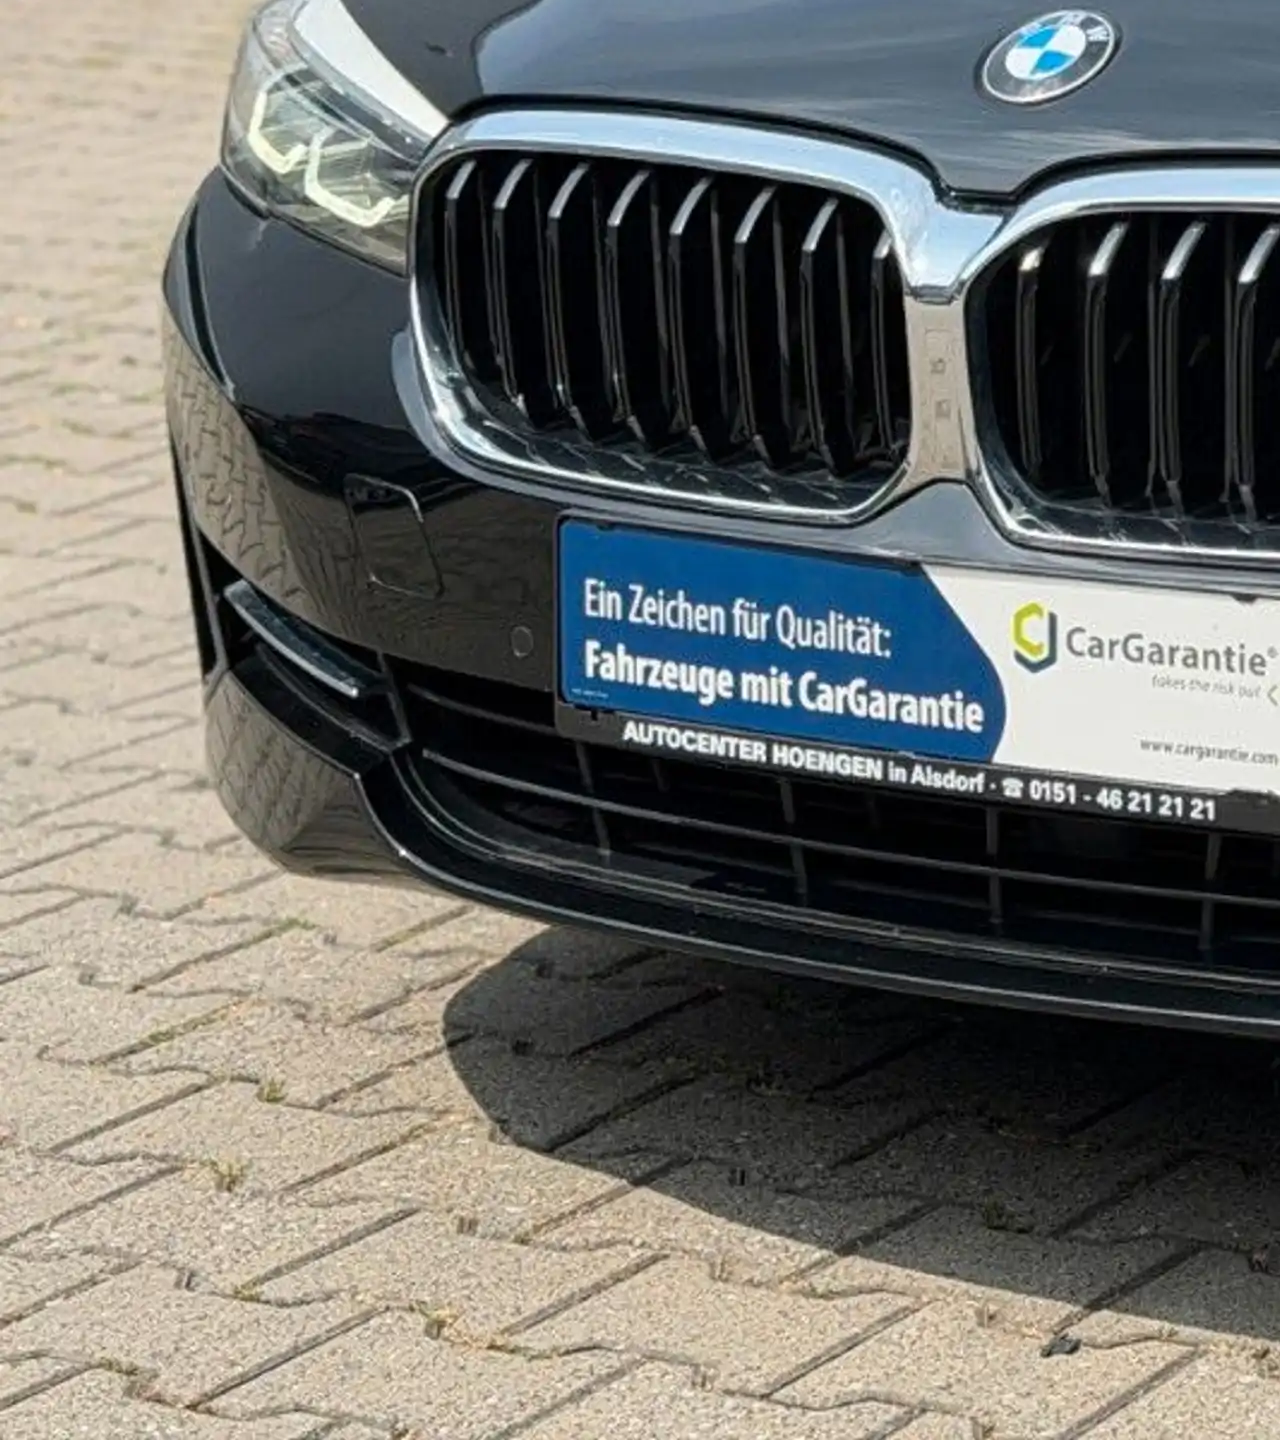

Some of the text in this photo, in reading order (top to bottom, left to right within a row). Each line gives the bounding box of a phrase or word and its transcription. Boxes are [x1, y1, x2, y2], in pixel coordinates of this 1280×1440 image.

[584, 578, 892, 659] Ein Zeichen für Qualität:
[584, 639, 985, 734] Fahrzeuge mit CarGarantie
[622, 720, 767, 763] AUTOCENTER
[772, 743, 883, 781] HOENGEN
[888, 764, 907, 784] in
[910, 764, 985, 794] Alsdorf
[1029, 779, 1077, 805] 0151
[1095, 788, 1123, 810] 46
[1127, 791, 1152, 813] 21
[1158, 795, 1184, 817] 21
[1190, 799, 1217, 822] 21
[1139, 738, 1280, 766] www.cargarantie.com
